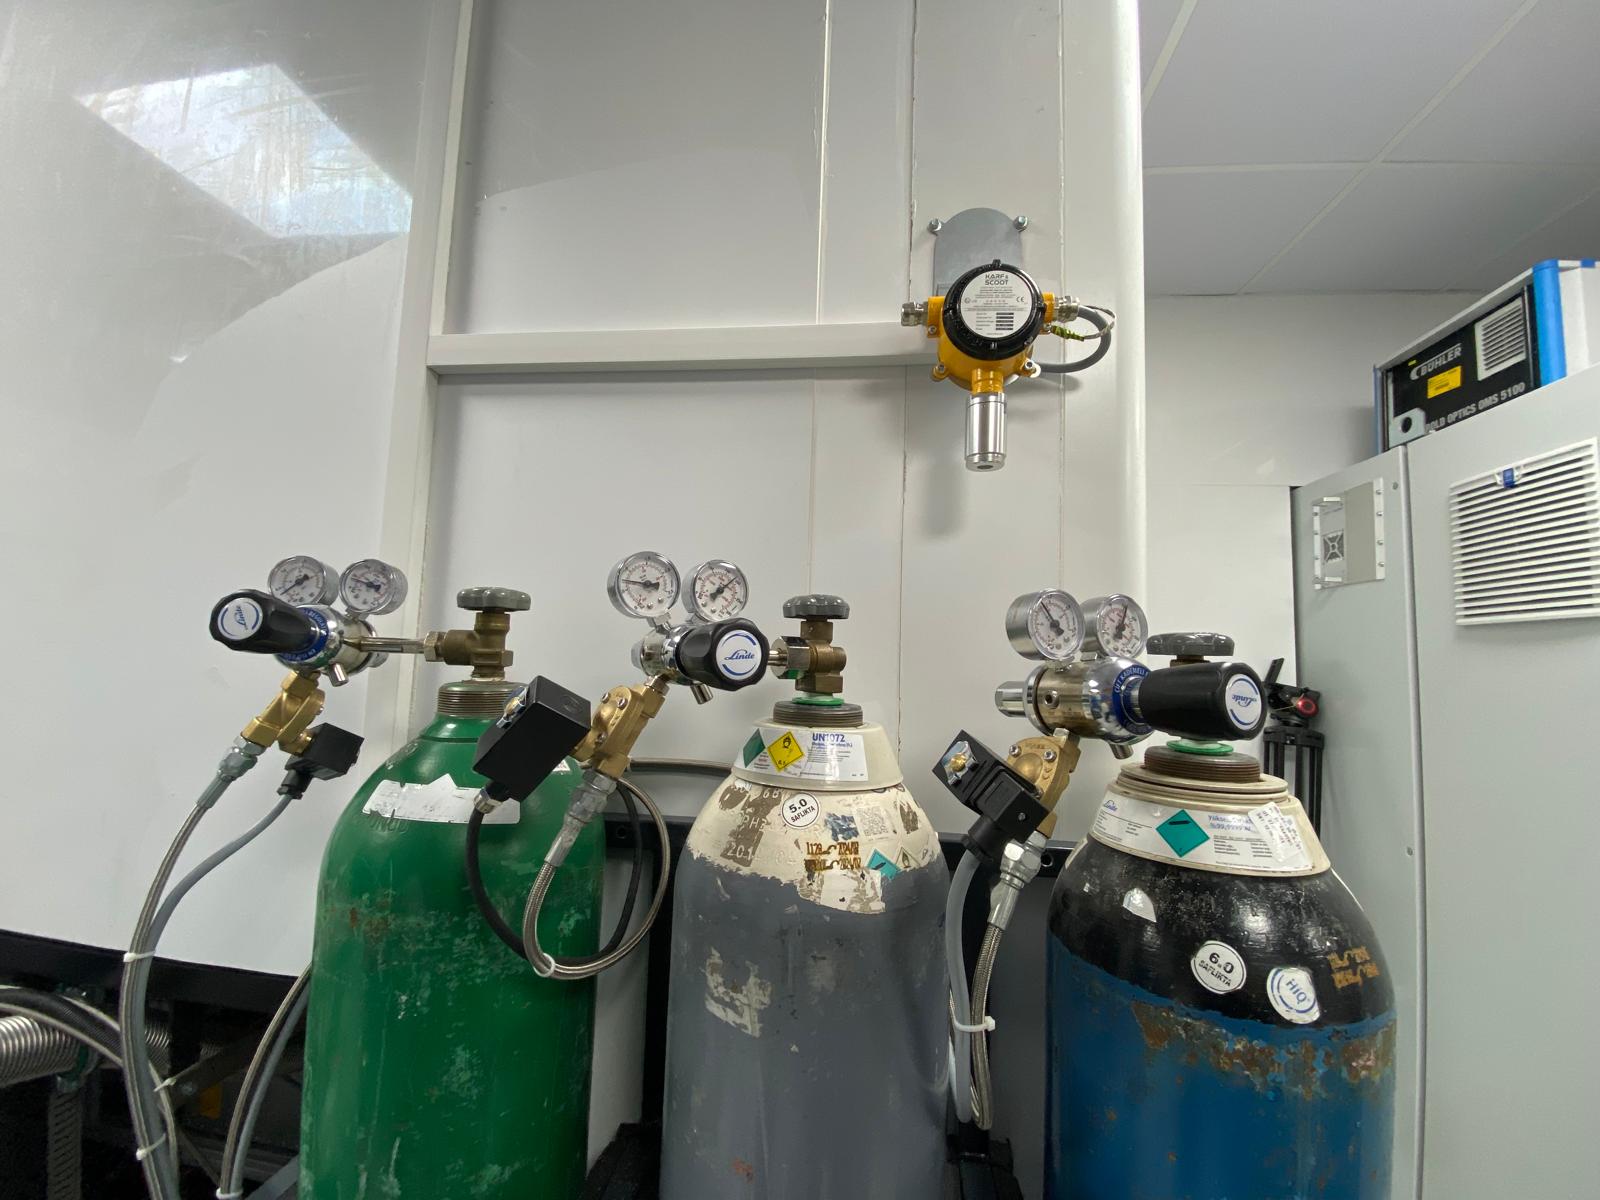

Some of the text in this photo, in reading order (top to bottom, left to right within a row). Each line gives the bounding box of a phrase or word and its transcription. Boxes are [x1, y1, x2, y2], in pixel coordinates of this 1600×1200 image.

[1447, 403, 1477, 423] OPTICS
[1500, 382, 1526, 401] 5100
[724, 649, 755, 661] Linde
[1230, 694, 1257, 708] Linde
[812, 732, 846, 743] UN1072
[789, 798, 808, 814] 5.0
[1208, 952, 1235, 975] 6.0
